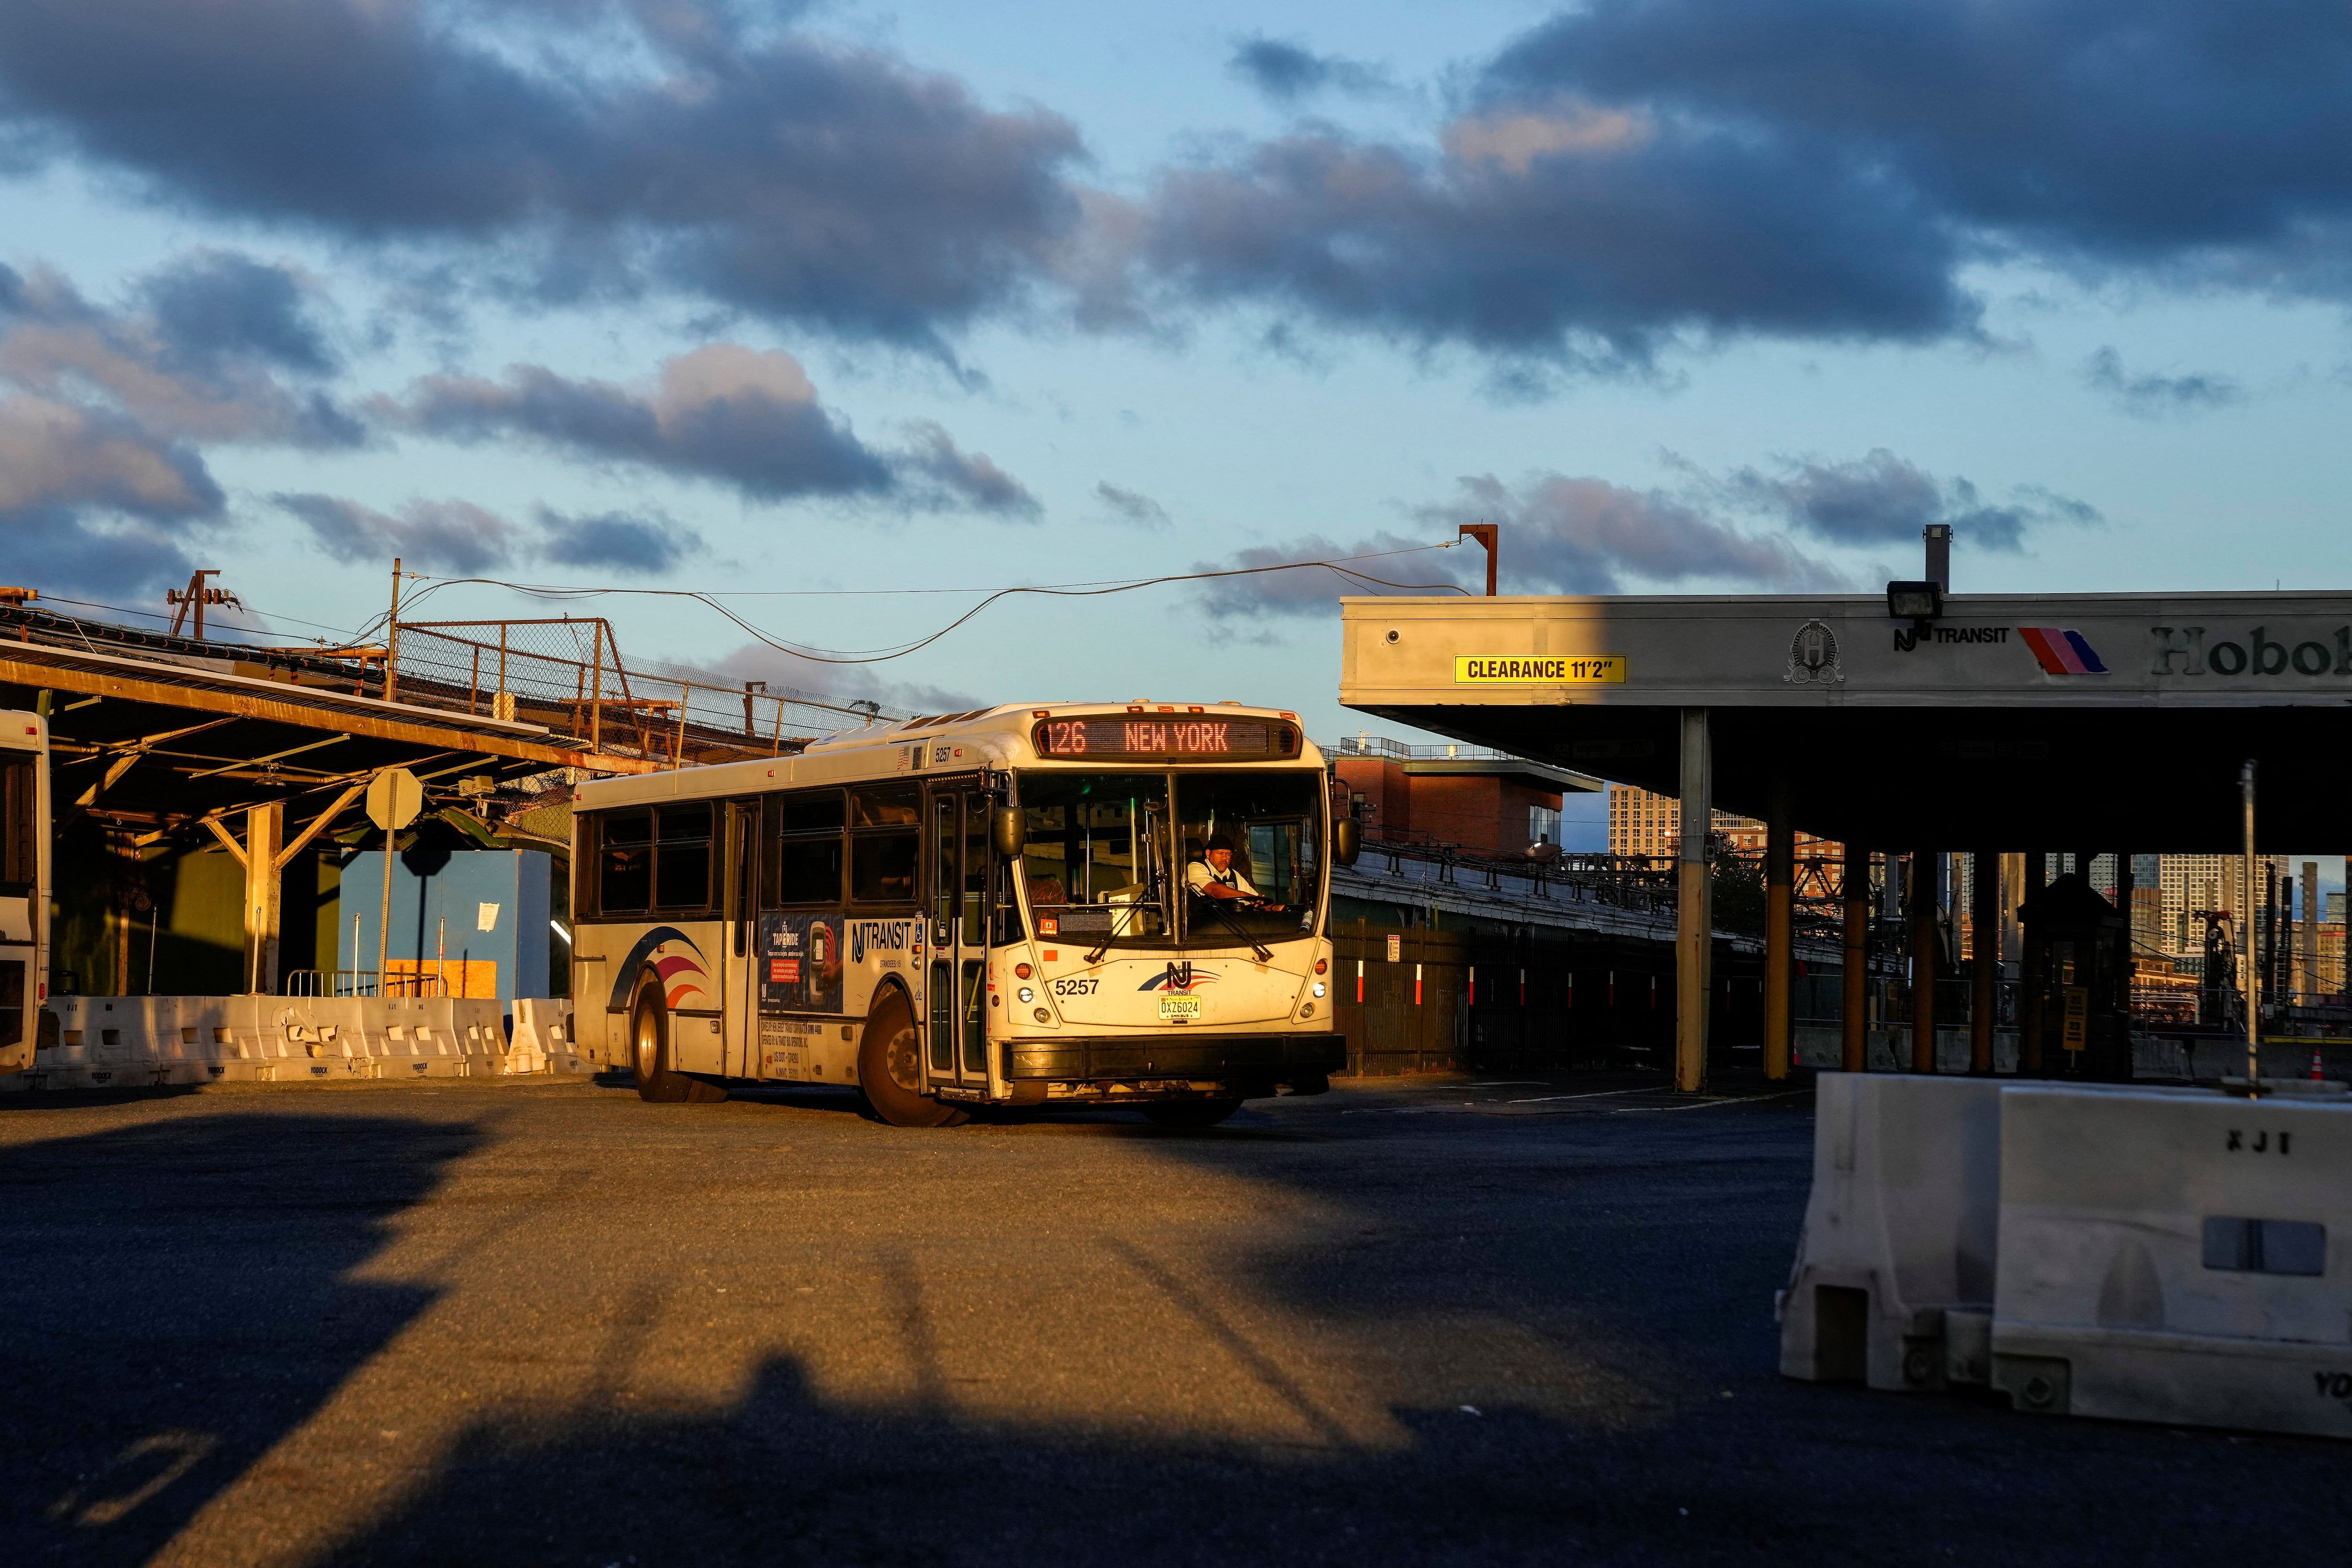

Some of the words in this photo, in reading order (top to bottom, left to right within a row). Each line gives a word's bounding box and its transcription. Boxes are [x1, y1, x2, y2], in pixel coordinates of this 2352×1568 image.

[1894, 628, 1916, 652] NJ
[1934, 628, 2010, 643] TRANSIT
[1468, 661, 1565, 678] CLEARANCE
[1125, 723, 1166, 751] NEW
[1173, 724, 1228, 751] YORK
[936, 747, 951, 763] 5257
[852, 922, 865, 964] NJ
[865, 921, 911, 950] TRANSIT
[1167, 961, 1192, 989] NJ
[1055, 979, 1099, 996] 5257
